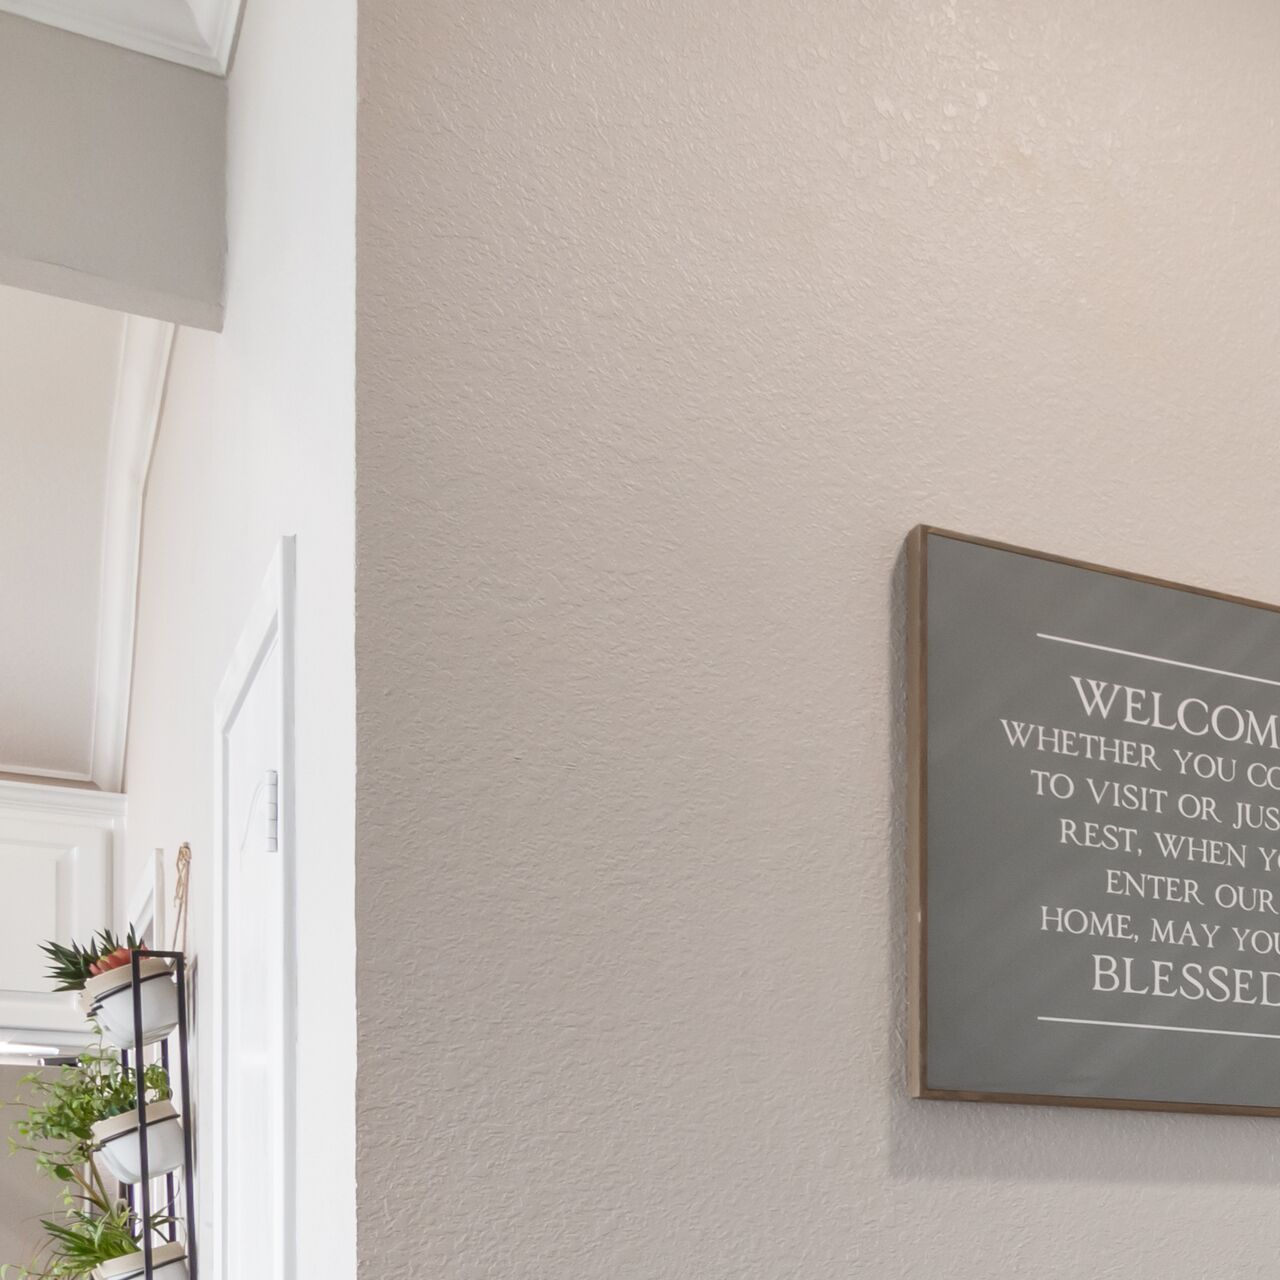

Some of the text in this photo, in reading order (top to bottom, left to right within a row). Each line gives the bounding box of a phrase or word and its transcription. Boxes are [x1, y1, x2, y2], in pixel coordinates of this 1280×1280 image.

[999, 718, 1162, 771] WHETHER
[1172, 748, 1237, 783] YOU
[1030, 769, 1075, 799] TO
[1086, 777, 1168, 814] VISIT
[1177, 793, 1223, 824] OR
[1060, 818, 1143, 857] REST,
[1153, 831, 1247, 868] WHEN
[1106, 869, 1279, 915] ENTER OUR
[1040, 905, 1139, 943] HOME,
[1150, 918, 1221, 949] MAY
